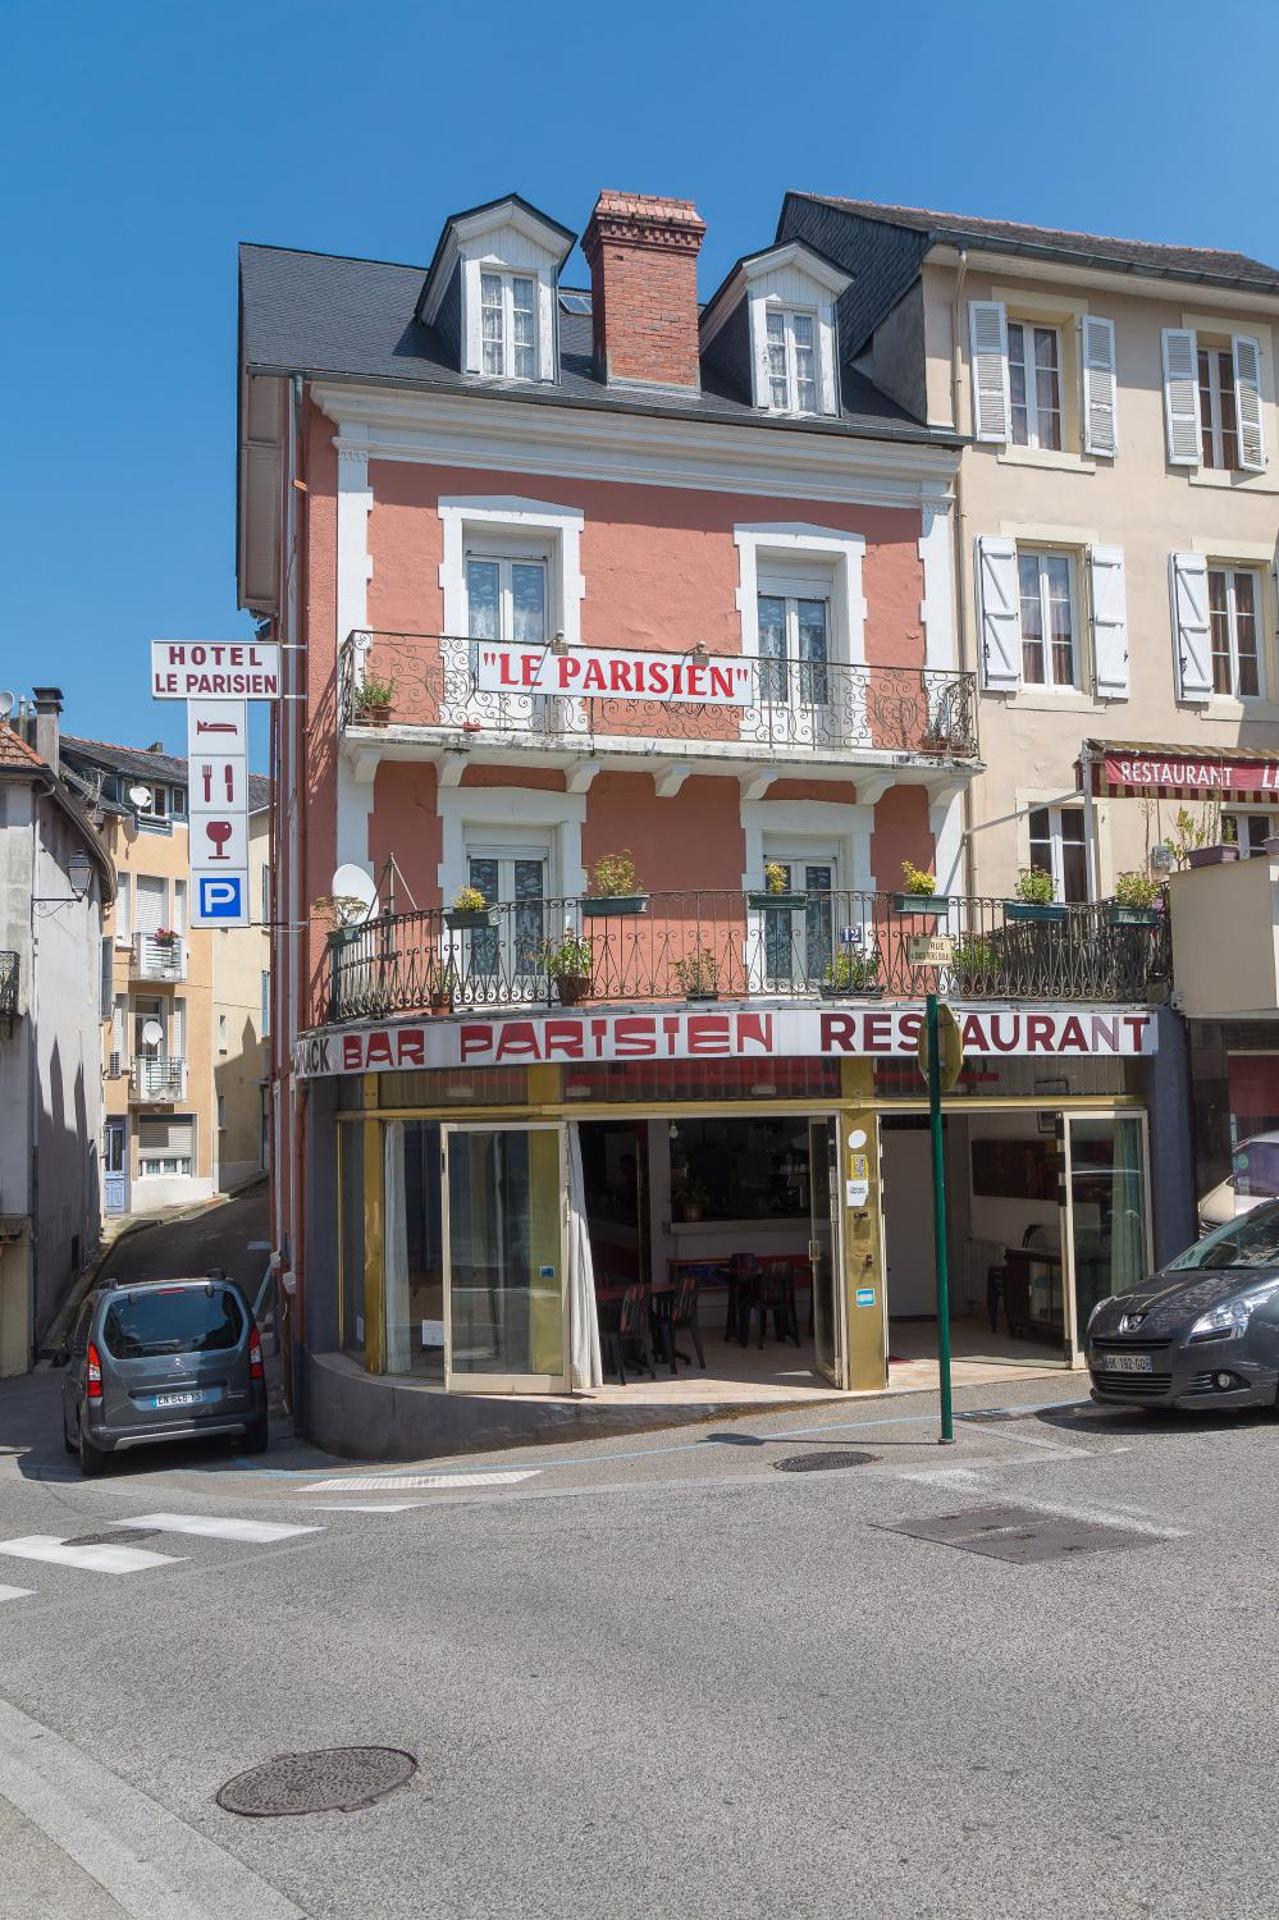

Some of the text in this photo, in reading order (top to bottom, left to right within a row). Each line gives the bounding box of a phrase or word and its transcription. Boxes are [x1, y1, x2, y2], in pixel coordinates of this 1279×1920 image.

[169, 646, 262, 666] HOTEL
[155, 673, 277, 693] LE PARISIEN
[483, 652, 749, 698] "LE PARISIEN"
[1120, 761, 1233, 787] RESTAURANT
[843, 928, 860, 942] 12
[930, 941, 945, 951] RUE
[343, 1028, 425, 1070] BAR
[461, 1013, 773, 1063] PARISIEN
[821, 1013, 1151, 1052] RESAURANT
